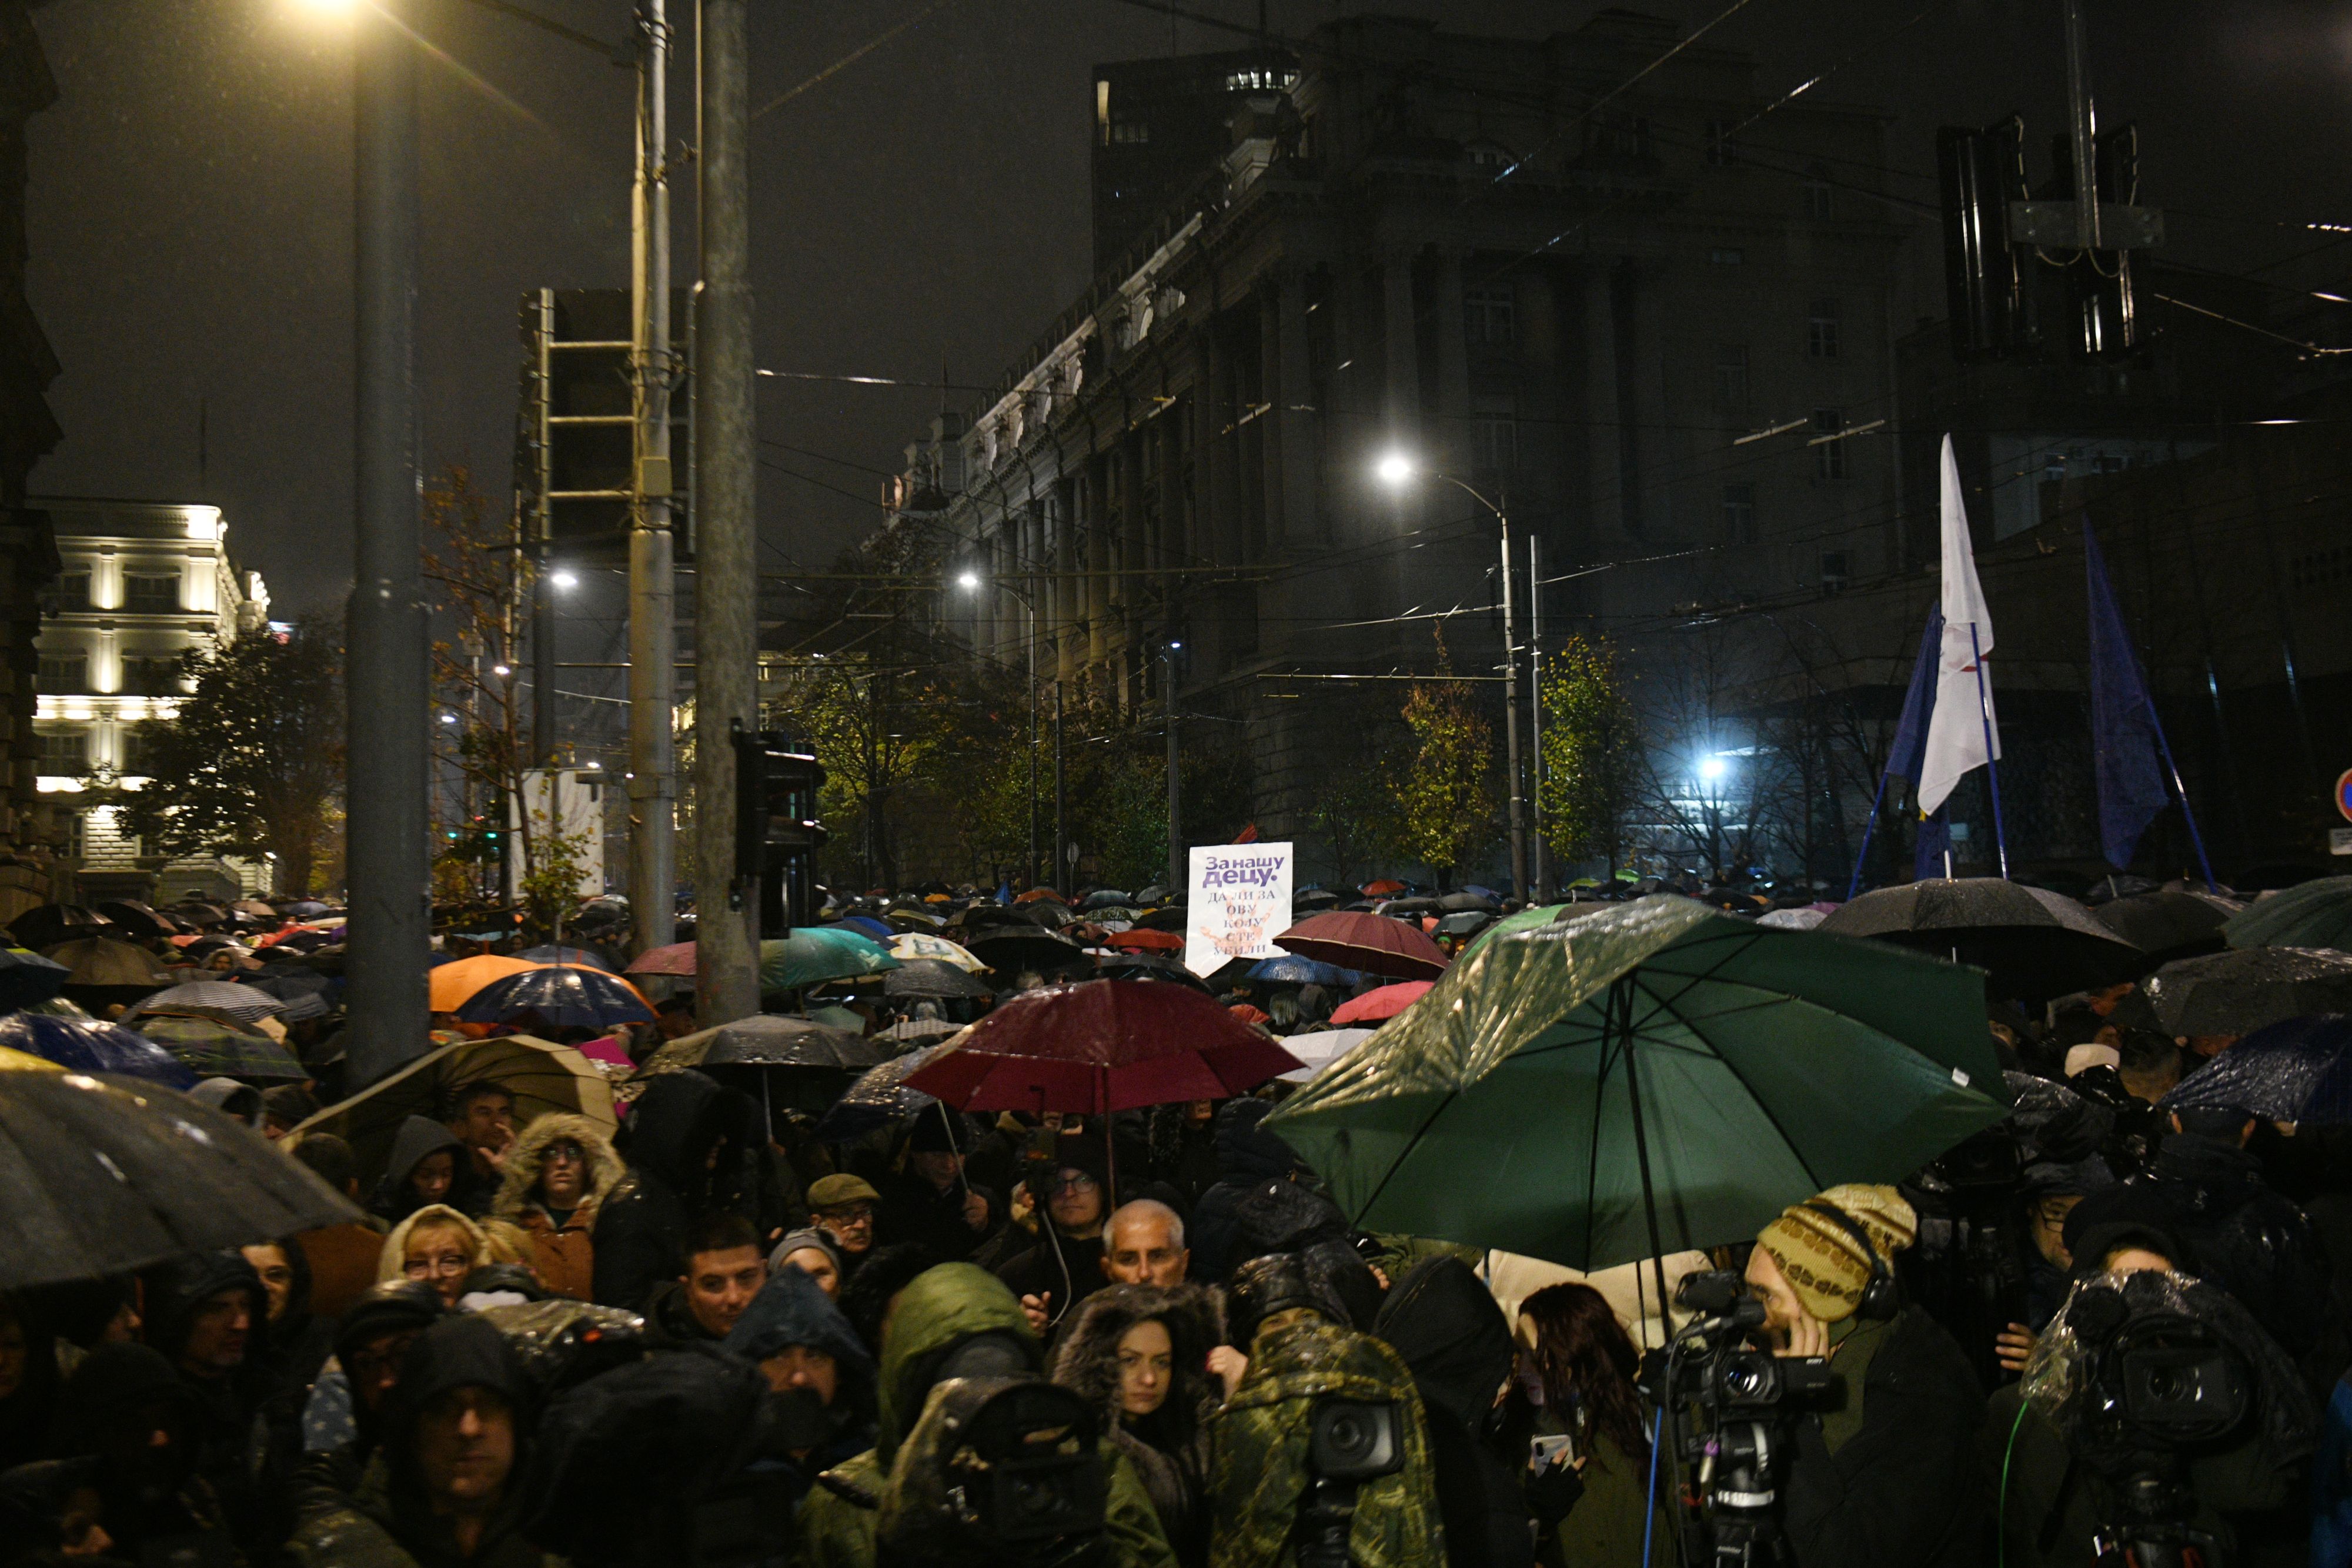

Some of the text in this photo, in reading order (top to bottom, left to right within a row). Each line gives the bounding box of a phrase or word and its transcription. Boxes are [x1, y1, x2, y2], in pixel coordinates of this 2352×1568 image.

[1206, 857, 1284, 870] За нашу
[1202, 868, 1278, 888] децу.
[1208, 890, 1275, 904] ДА ЛИ ЗА
[1227, 905, 1257, 915] ОВУ
[1224, 918, 1262, 928] КОЈУ
[1226, 932, 1255, 941] СТЕ
[1214, 945, 1266, 955] УБИЛИ
